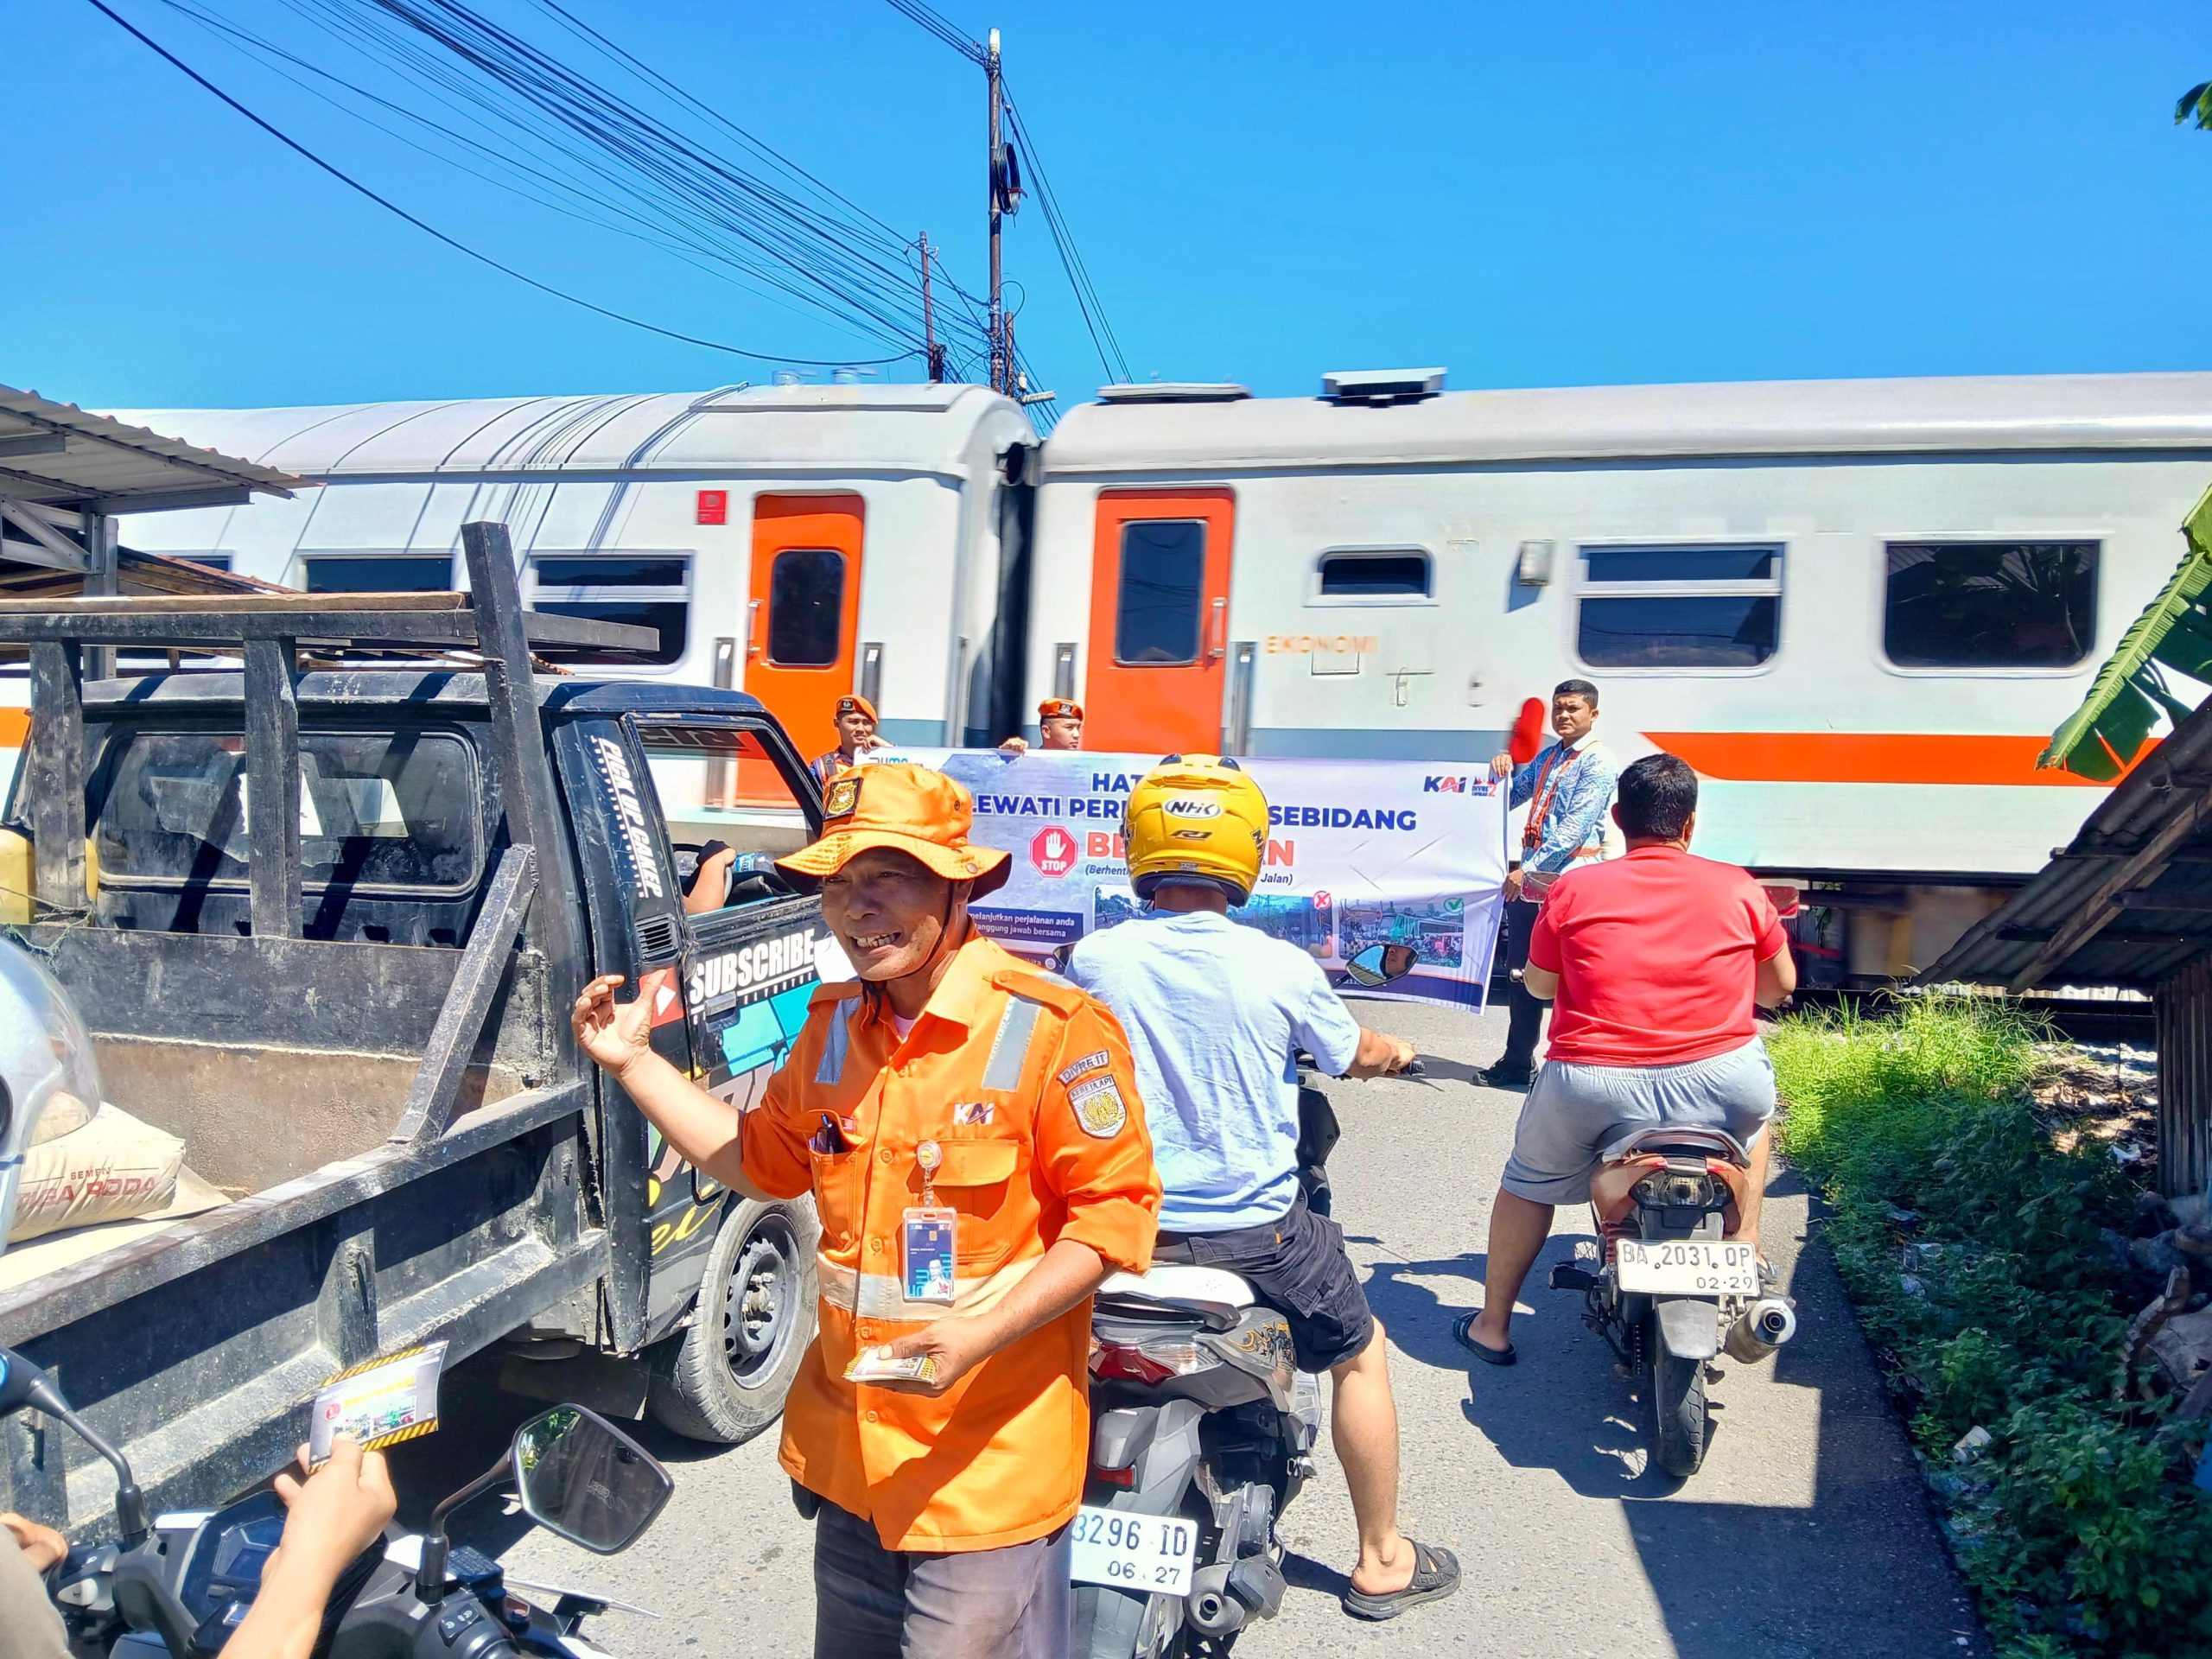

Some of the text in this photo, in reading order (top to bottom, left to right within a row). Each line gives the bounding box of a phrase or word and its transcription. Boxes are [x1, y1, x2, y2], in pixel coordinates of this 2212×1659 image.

[598, 737, 636, 796] PICK
[1424, 776, 1467, 793] KAI
[620, 793, 645, 827] UP
[973, 794, 1061, 817] EWATI
[1268, 805, 1417, 831] SEBIDANG
[631, 826, 664, 899] CAKEP
[1041, 860, 1067, 871] STOP
[1261, 873, 1294, 886] Jalan)
[1009, 925, 1032, 935] jawab
[1033, 926, 1066, 938] bersama
[1014, 914, 1054, 925] perjalanan
[1055, 917, 1075, 927] anda
[690, 928, 815, 1005] SUBSCRIBE
[1098, 1077, 1112, 1089] API
[953, 1102, 995, 1125] KAI
[70, 1166, 111, 1180] SEMEN
[1622, 1243, 1648, 1264] BA
[1662, 1245, 1711, 1267] 2031
[1159, 1524, 1187, 1556] ID
